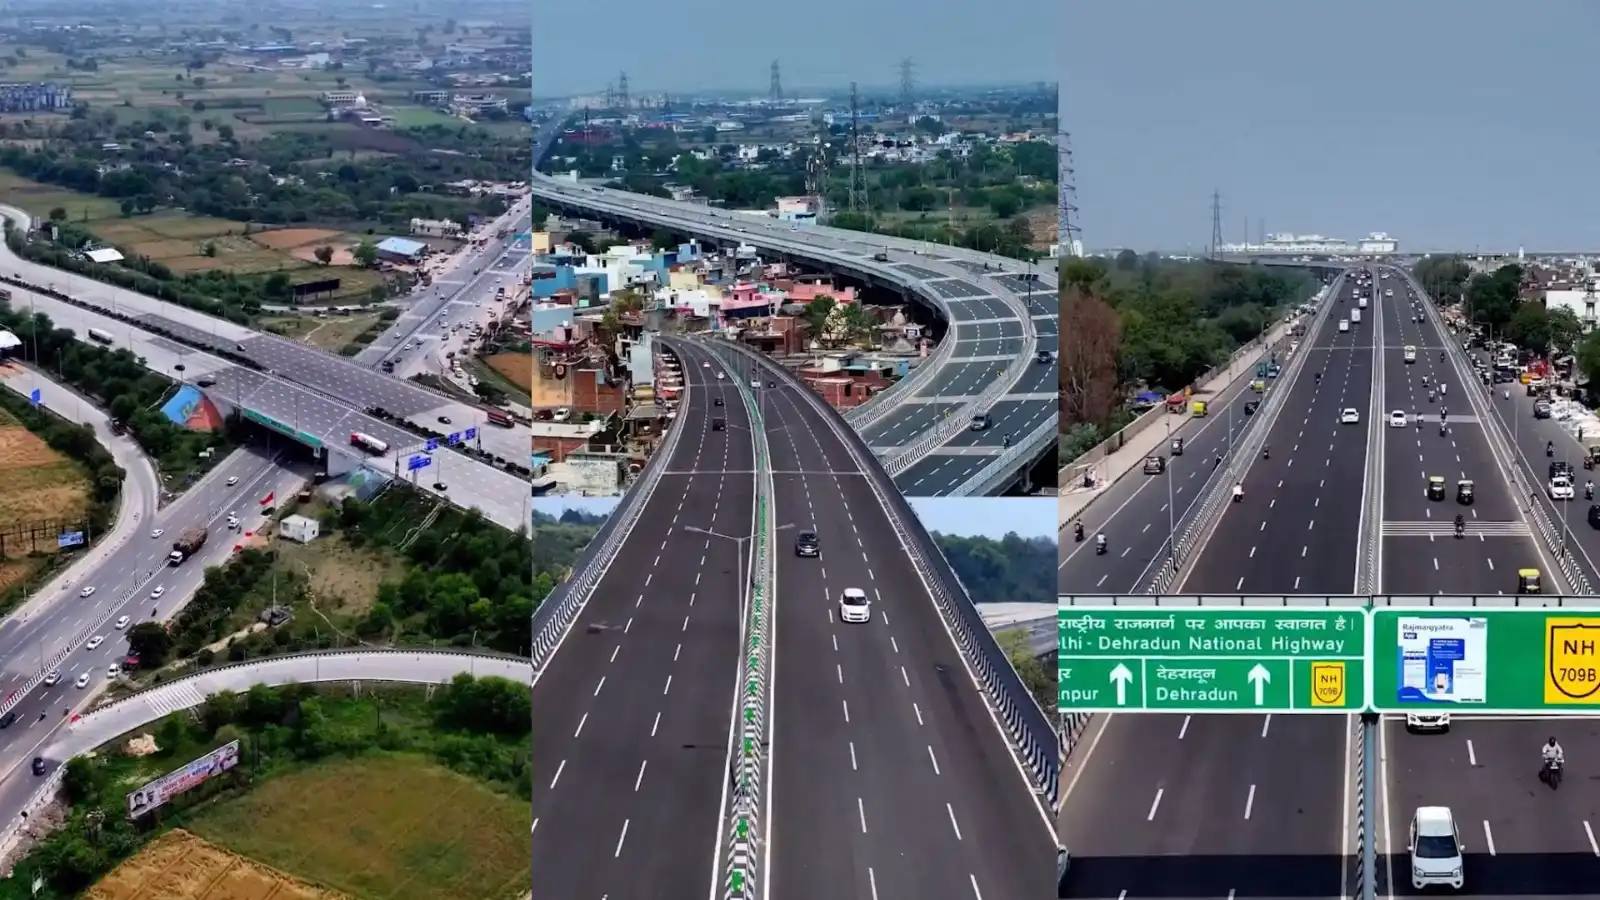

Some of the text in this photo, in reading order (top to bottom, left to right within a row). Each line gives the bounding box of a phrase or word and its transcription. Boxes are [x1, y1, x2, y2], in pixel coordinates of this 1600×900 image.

[1058, 615, 1105, 634] राष्ट्रीय
[1114, 615, 1174, 630] राजमार्ग
[1186, 620, 1205, 630] पर
[1215, 620, 1265, 630] आपका
[1275, 620, 1326, 630] स्वागत
[1099, 637, 1180, 650] Dehradun
[1190, 637, 1261, 650] National
[1272, 637, 1343, 654] Highway
[1564, 640, 1594, 655] NH
[1157, 665, 1215, 684] देहरादून
[1321, 674, 1337, 683] NH
[1560, 668, 1597, 682] 709B
[1058, 690, 1098, 702] npur
[1157, 687, 1237, 701] Dehradun
